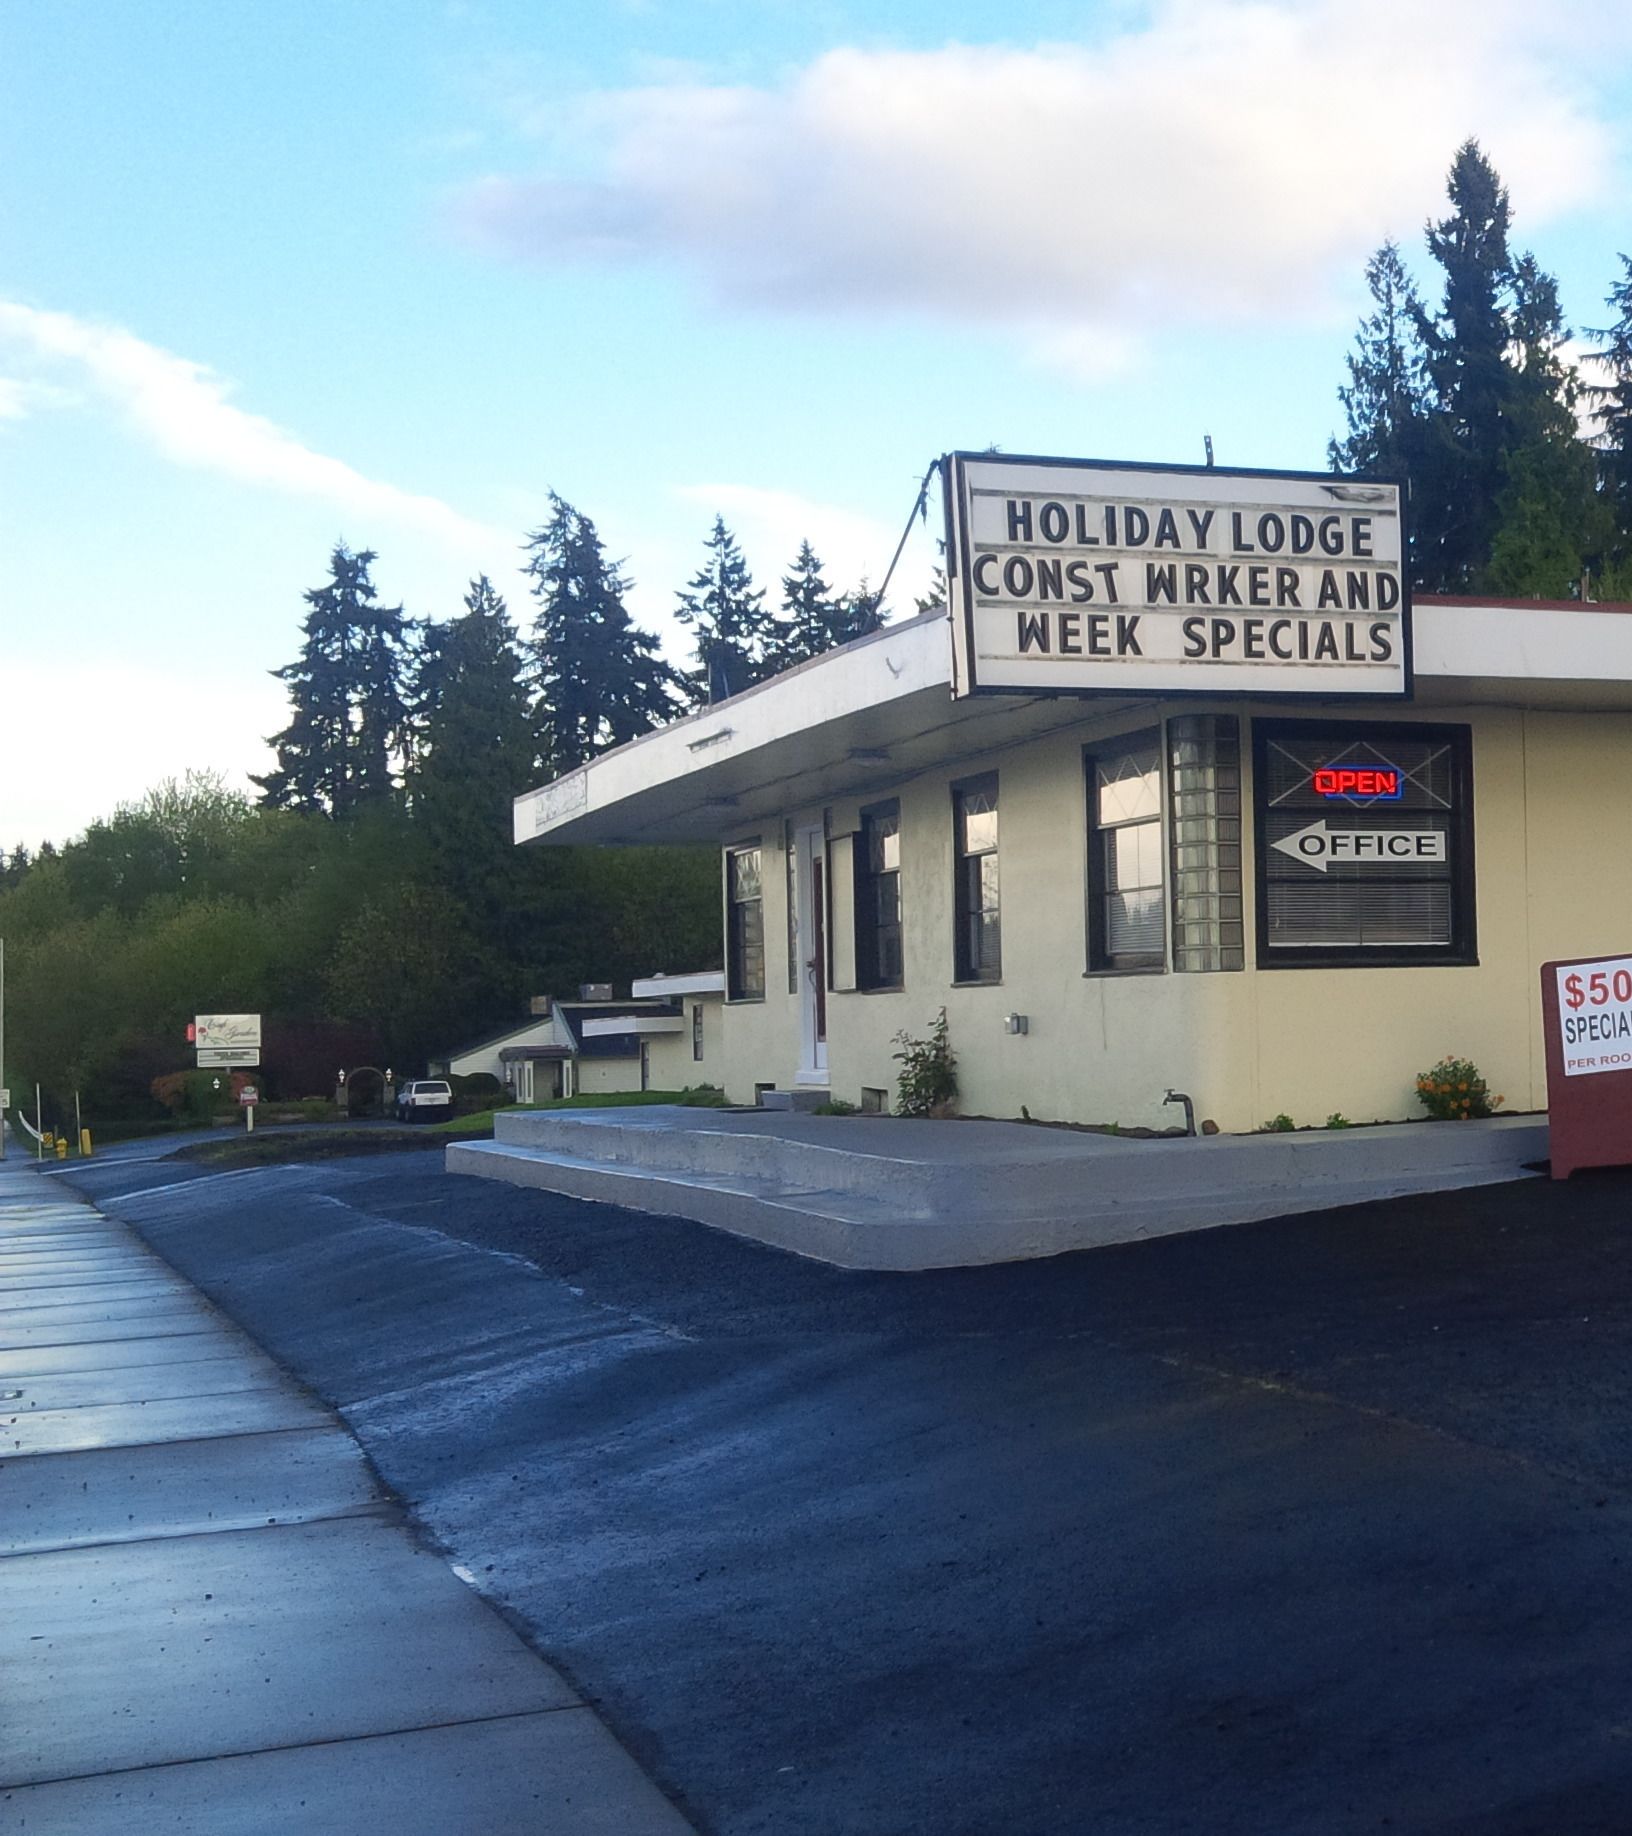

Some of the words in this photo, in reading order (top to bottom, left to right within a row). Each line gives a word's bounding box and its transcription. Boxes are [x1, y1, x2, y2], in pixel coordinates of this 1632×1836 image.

[1006, 499, 1214, 550] HOLIDAY
[1231, 511, 1374, 557] LODGE
[972, 553, 1121, 603] CONST
[1145, 562, 1301, 607] WRKER
[1317, 569, 1400, 612] AND
[1017, 611, 1144, 656] WEEK
[1183, 616, 1393, 662] SPECIALS
[1314, 770, 1395, 793] OPEN
[1298, 834, 1438, 856] OFFICE
[1564, 969, 1632, 1012] $50
[1567, 1058, 1596, 1070] PER
